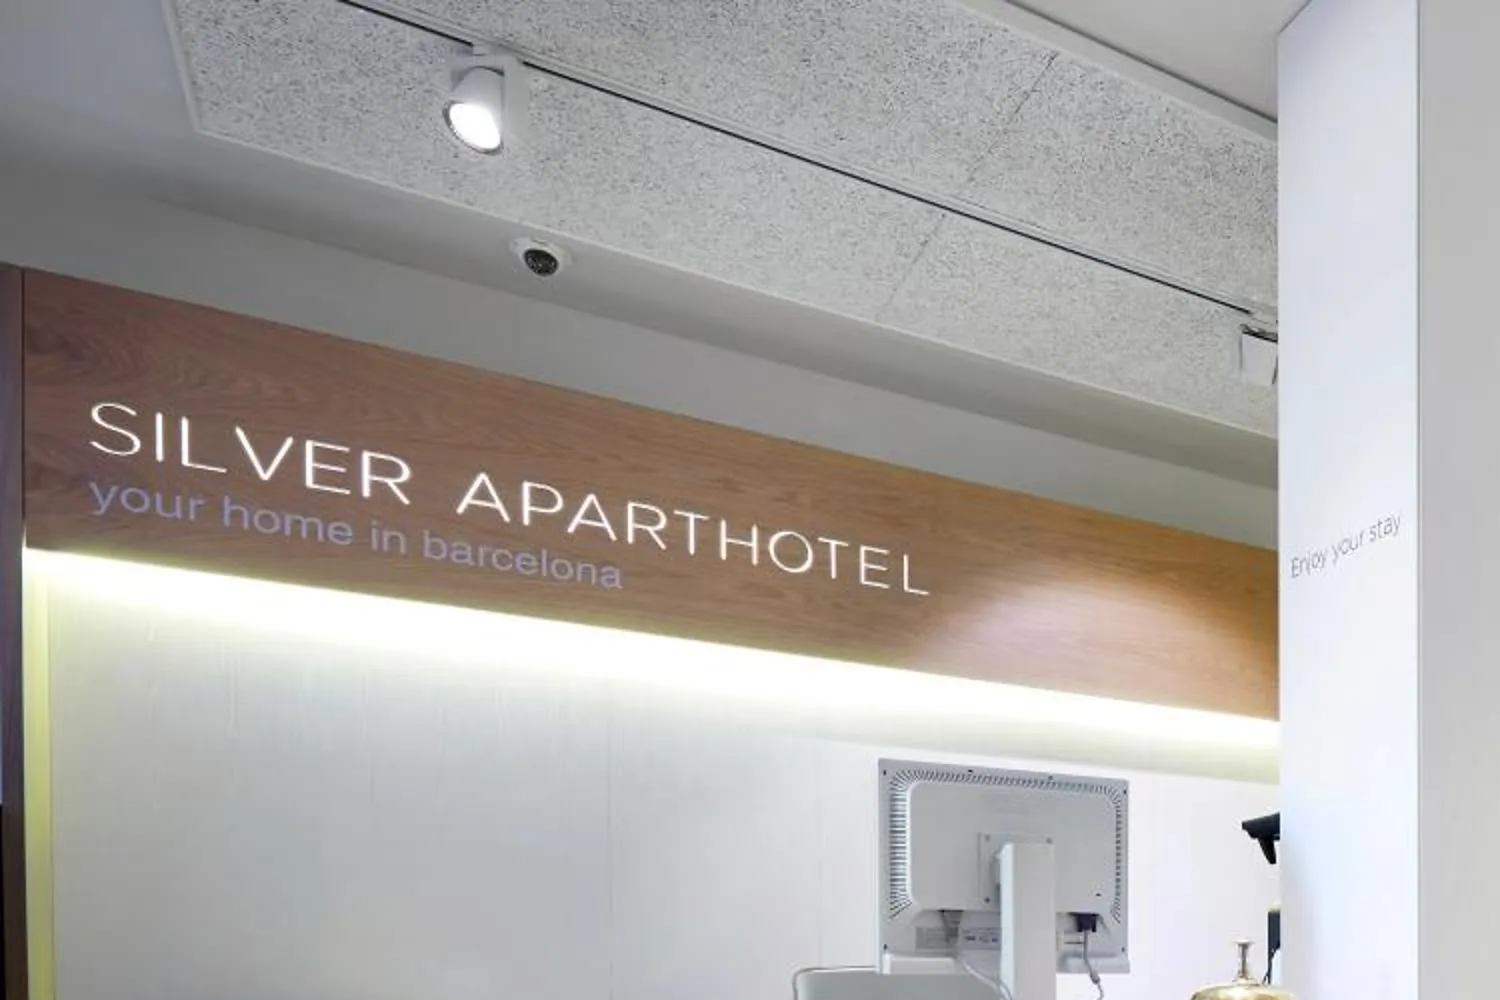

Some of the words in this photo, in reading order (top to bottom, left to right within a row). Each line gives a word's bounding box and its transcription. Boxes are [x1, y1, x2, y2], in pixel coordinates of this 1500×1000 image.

[88, 481, 205, 521] your
[223, 495, 352, 546] home
[370, 519, 407, 554] in
[423, 529, 624, 590] barcelona
[89, 402, 411, 505] SILVER
[456, 471, 929, 595] APARTHOTEL
[1290, 550, 1327, 579] Enjoy
[1331, 529, 1365, 566] your
[1369, 513, 1401, 543] stay
